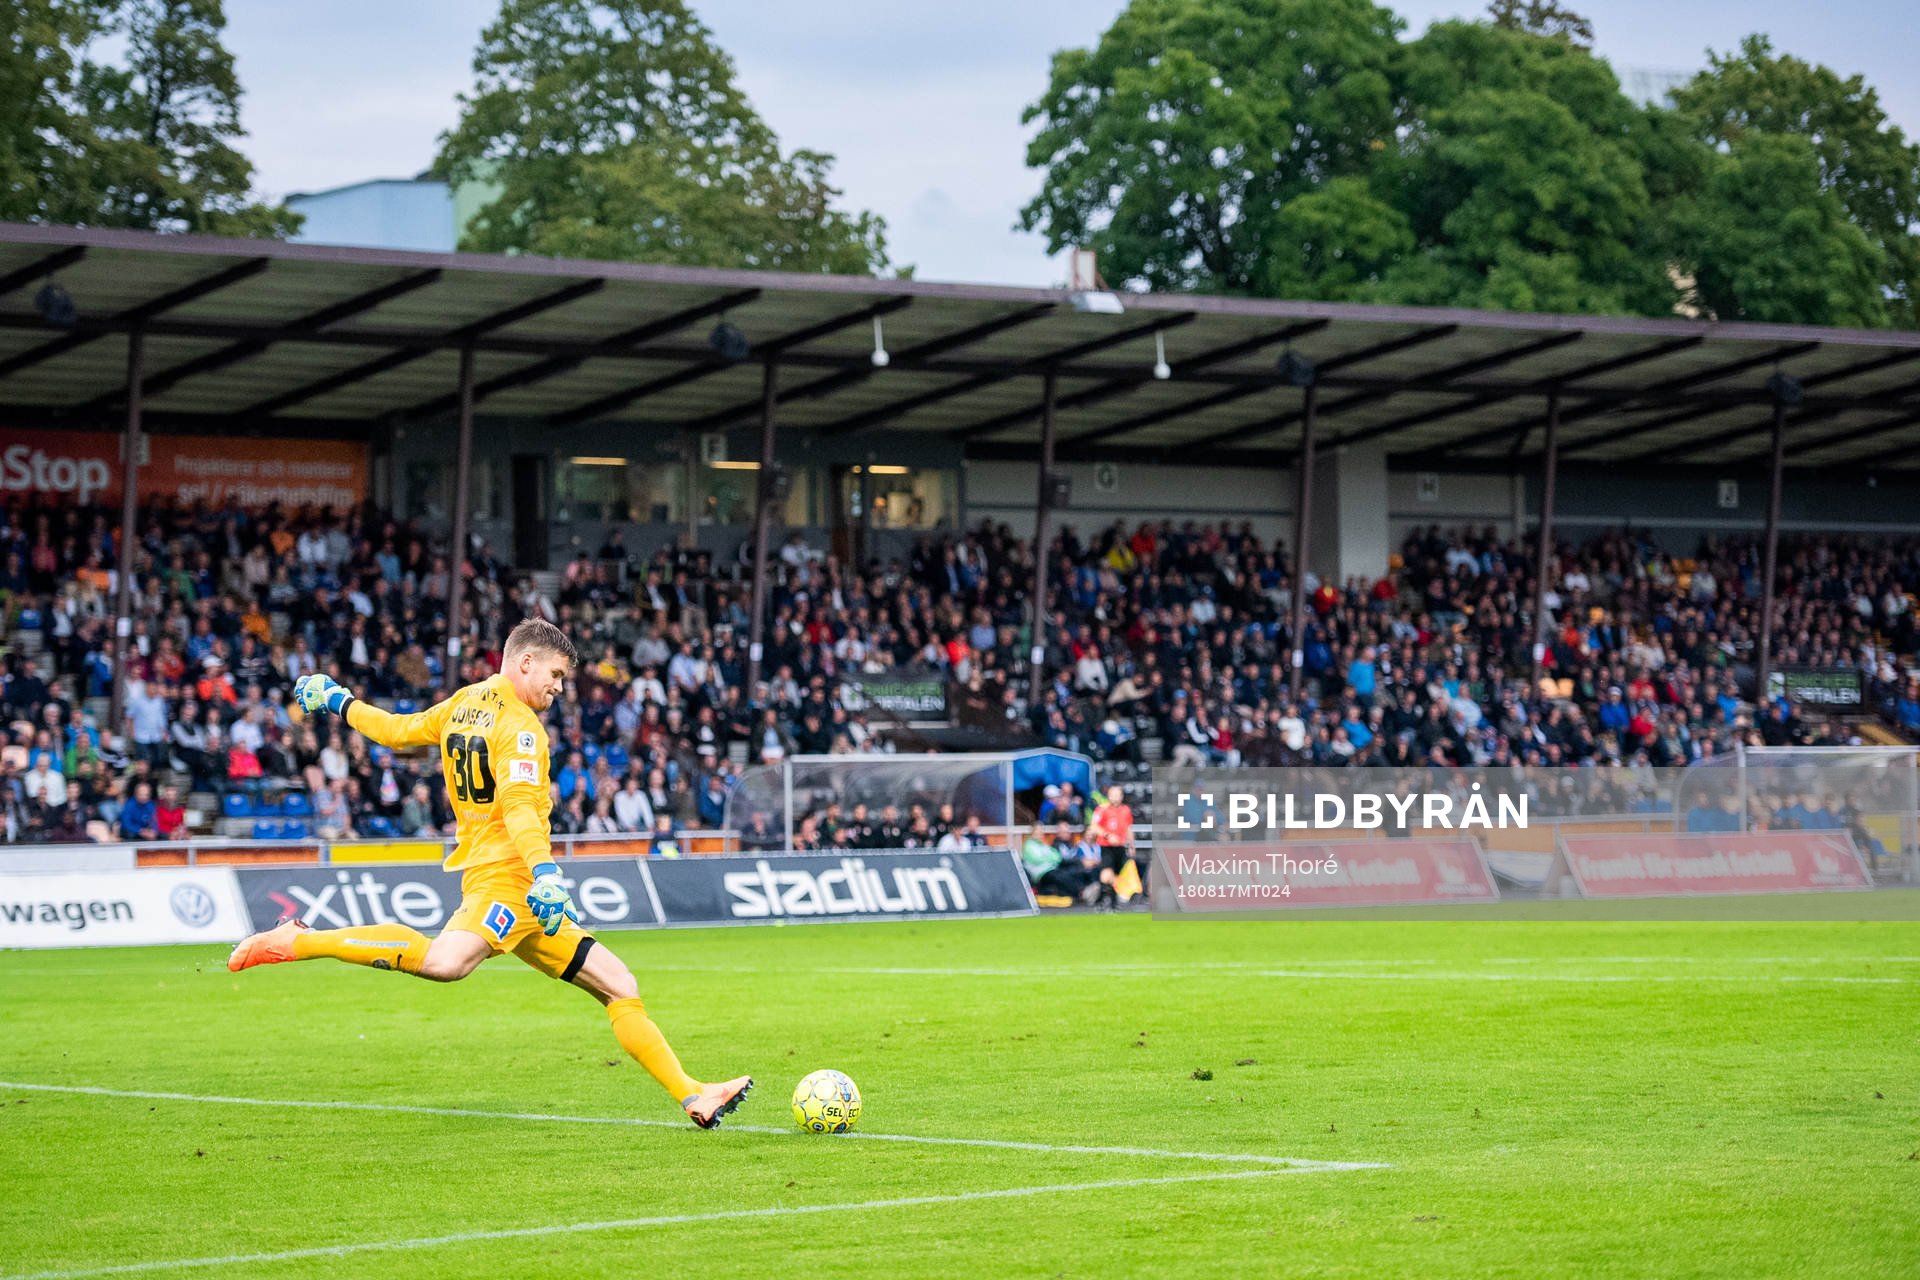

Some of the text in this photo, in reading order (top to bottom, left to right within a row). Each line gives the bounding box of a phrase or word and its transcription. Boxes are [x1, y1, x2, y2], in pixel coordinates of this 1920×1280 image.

[0, 443, 110, 507] Stop
[446, 733, 496, 804] 30
[0, 898, 134, 930] wagen
[723, 857, 969, 918] stadium
